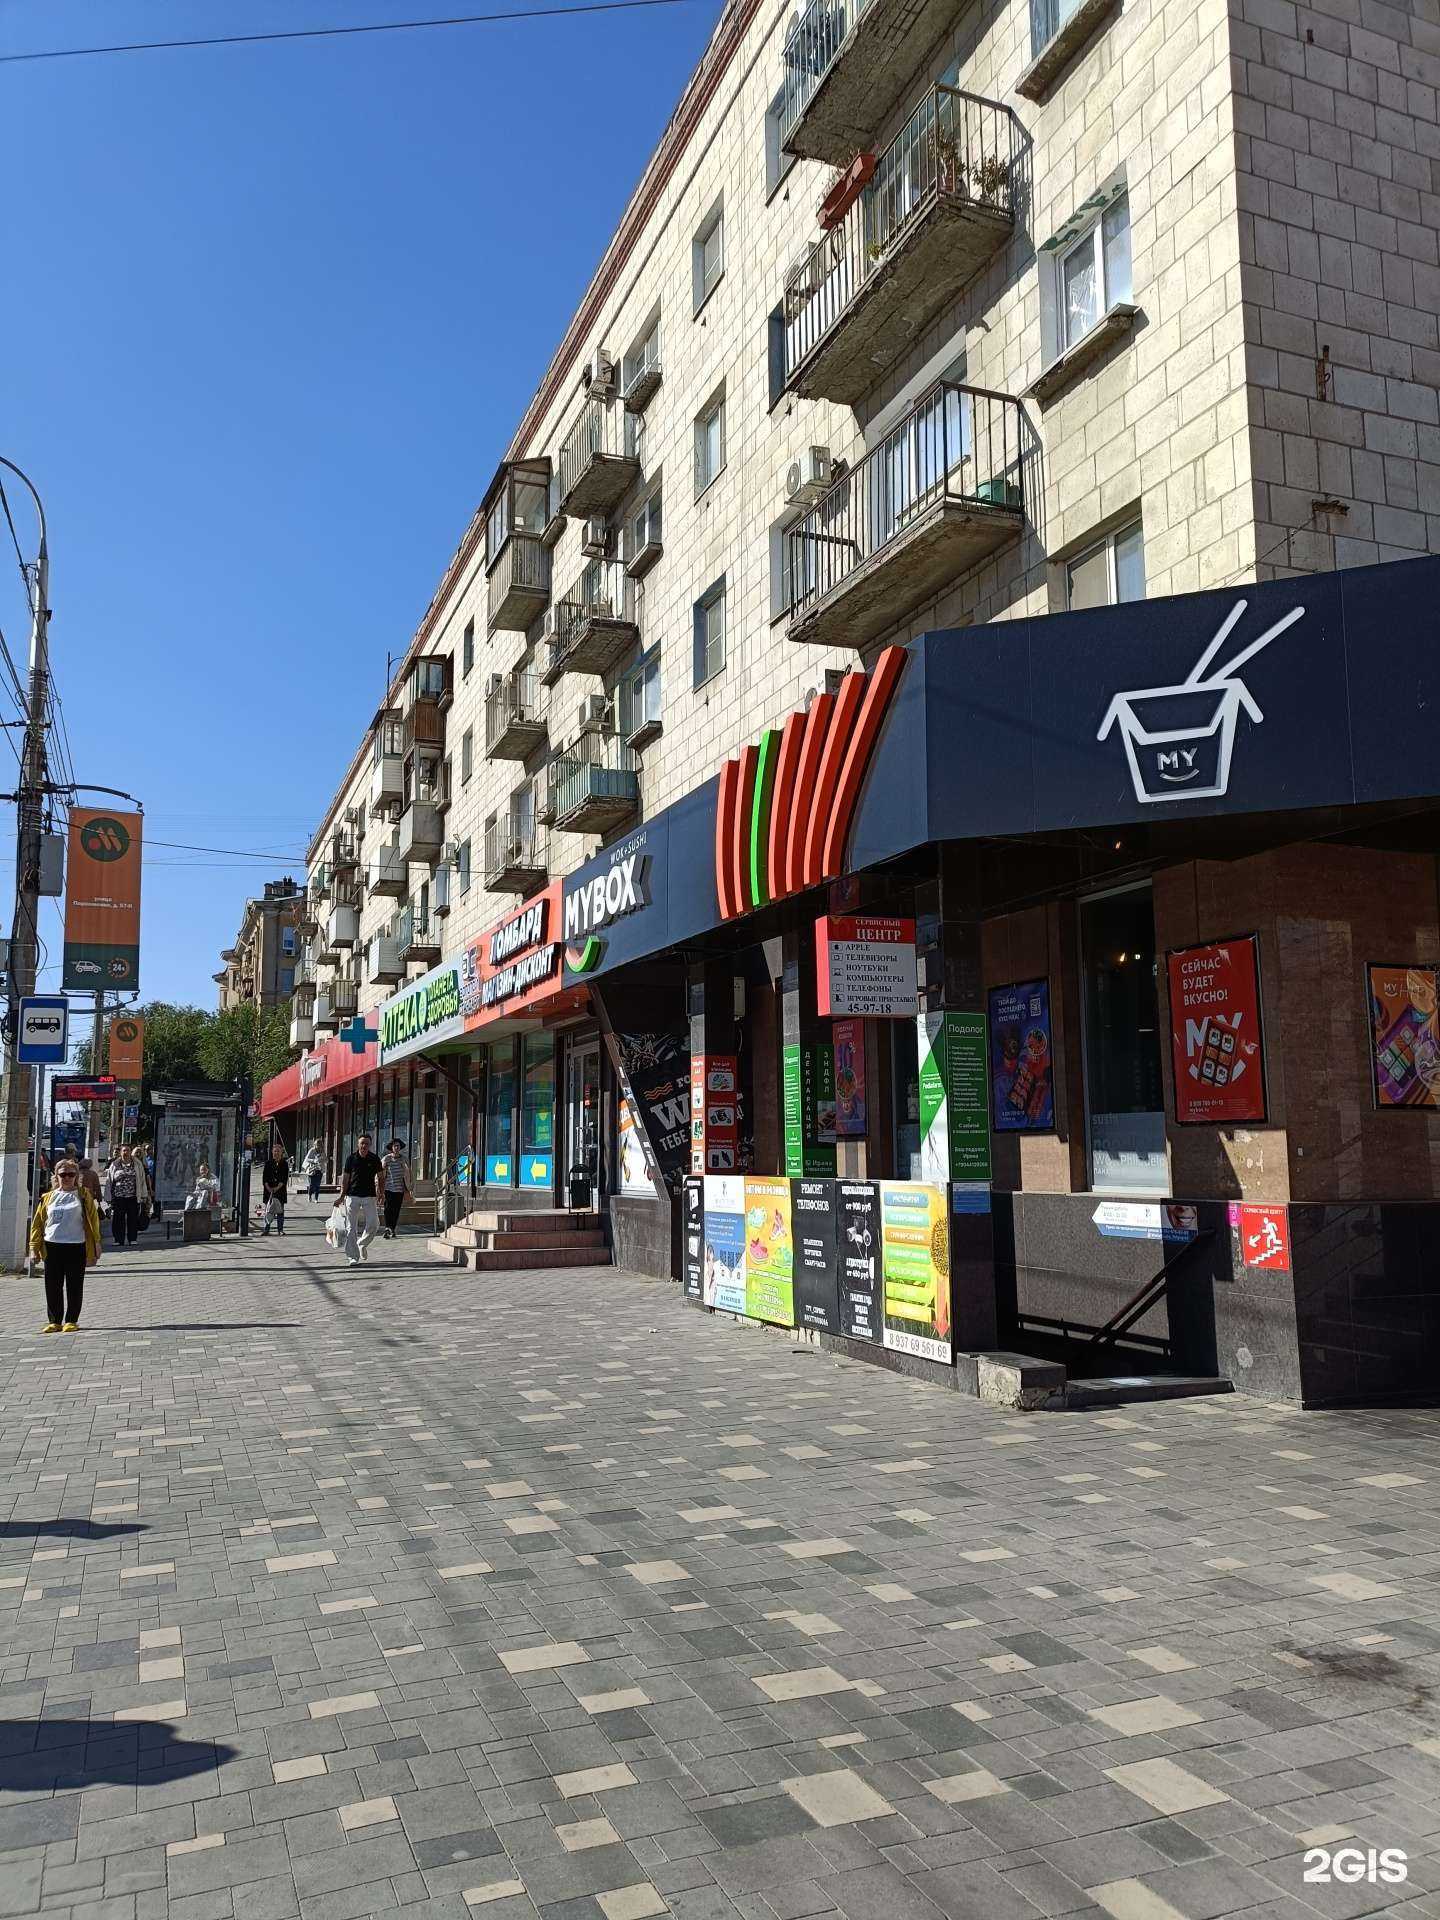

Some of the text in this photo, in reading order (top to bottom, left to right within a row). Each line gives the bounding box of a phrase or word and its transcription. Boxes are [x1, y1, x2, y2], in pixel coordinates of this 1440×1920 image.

[1157, 747, 1198, 770] MY
[564, 854, 638, 940] MYBOX
[855, 918, 901, 927] СЕРВИСНЫЙ
[490, 899, 544, 965] ЛОМБАРД
[856, 928, 902, 942] ЦЕНТР
[845, 943, 871, 952] APPLE
[845, 953, 898, 963] ТЕЛЕВИЗОРЫ
[846, 963, 889, 973] НОУТБУКИ
[1181, 956, 1222, 974] СЕЙЧАС
[846, 974, 905, 983] КОМПЬЮТЕРЫ
[1182, 974, 1215, 991] БУДЕТ
[846, 984, 893, 993] ТЕЛЕФОНЫ
[877, 995, 917, 1003] ПРИСТАВКИ
[1183, 988, 1229, 1007] ВКУСНО!
[847, 1003, 892, 1014] 45-97-18
[380, 994, 418, 1048] АПТЕКА
[948, 1024, 984, 1034] Подолог
[659, 1129, 689, 1151] ТЕБЕ
[800, 1183, 824, 1195] РЕМОНТ
[796, 1198, 830, 1212] ТЕЛЕФОНОВ
[861, 1203, 872, 1213] руб
[895, 1334, 909, 1348] 937
[911, 1337, 920, 1351] 69
[921, 1341, 935, 1355] 561
[937, 1344, 948, 1359] 69
